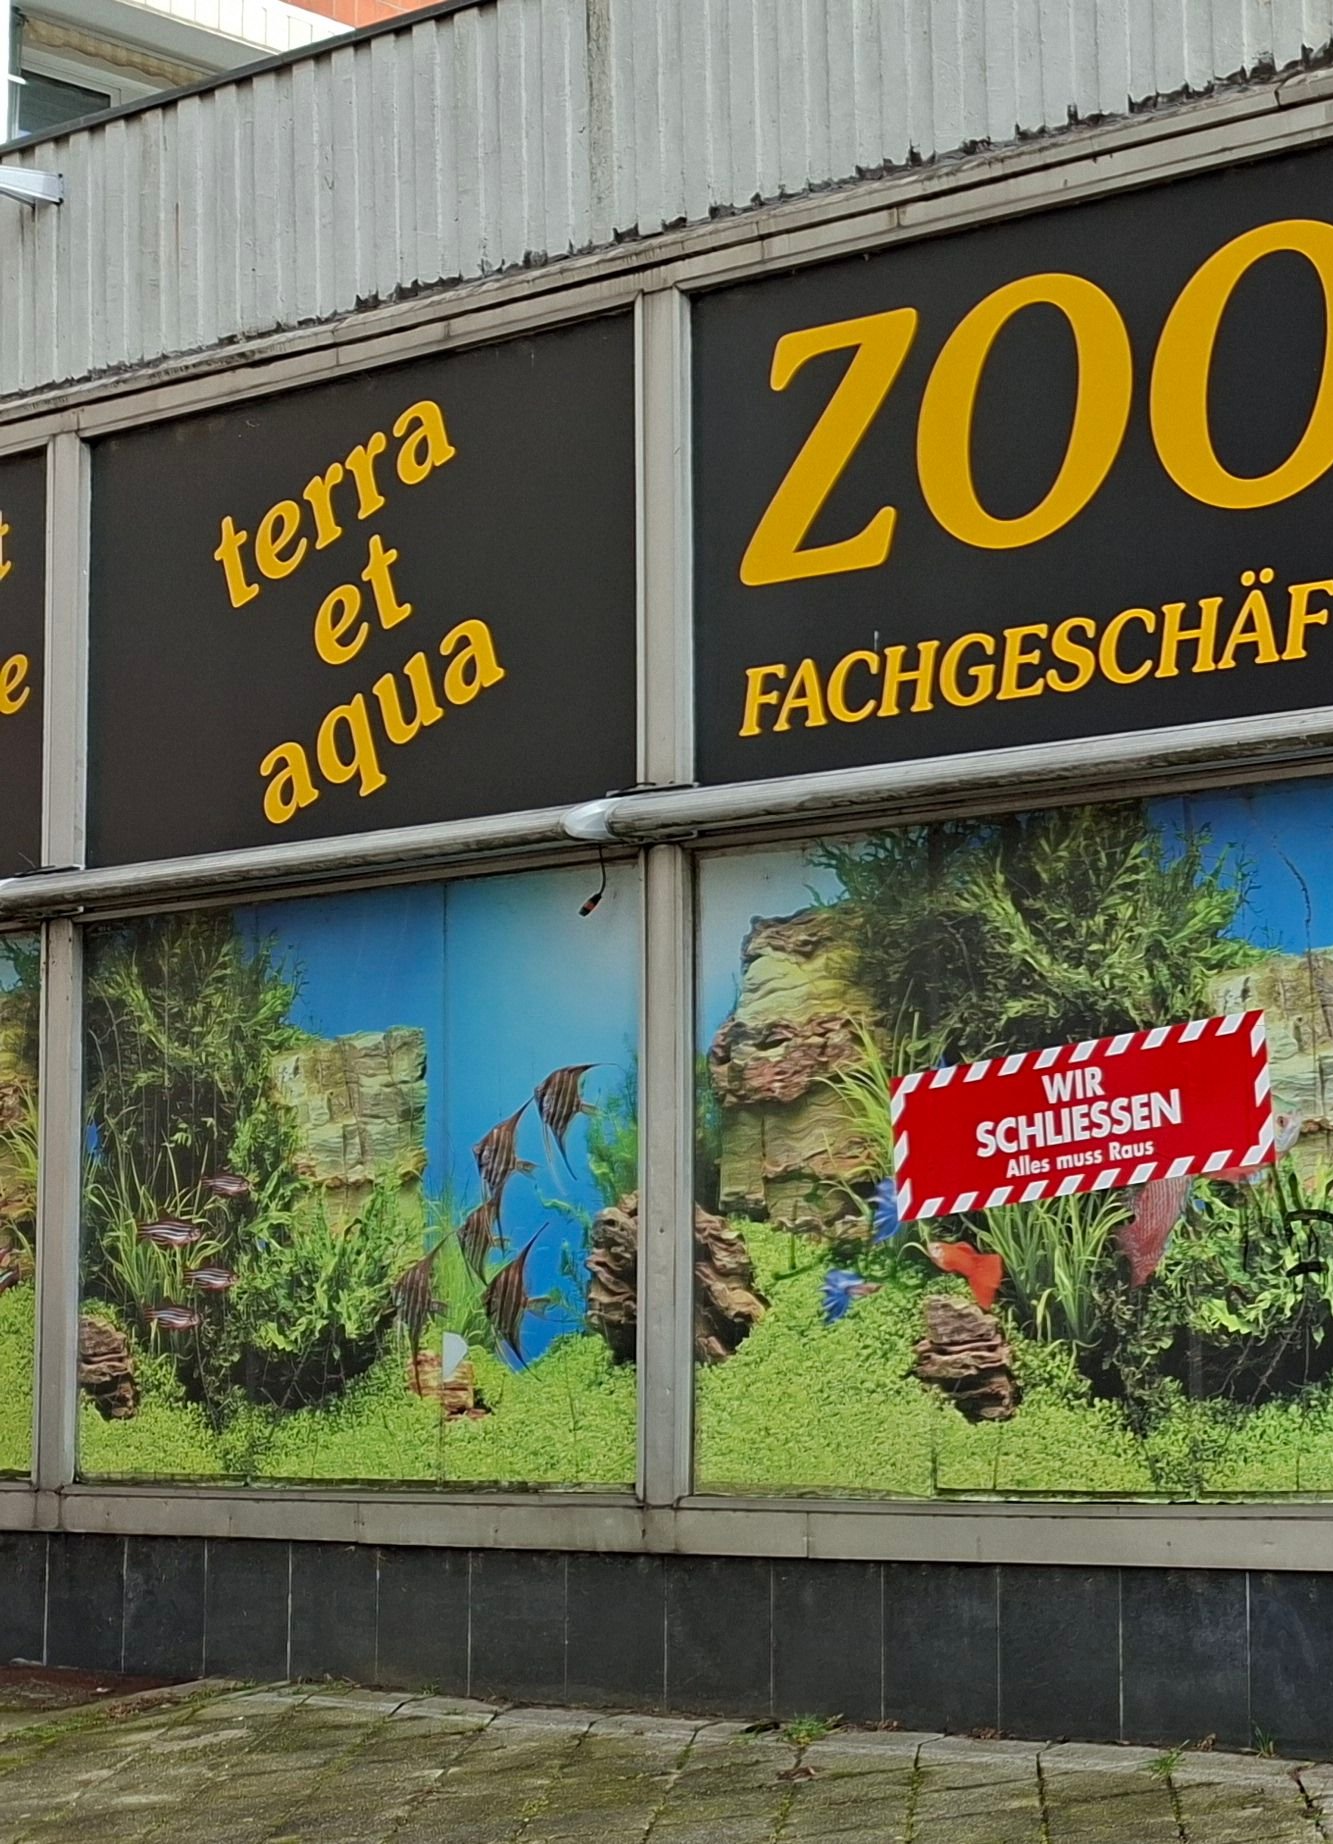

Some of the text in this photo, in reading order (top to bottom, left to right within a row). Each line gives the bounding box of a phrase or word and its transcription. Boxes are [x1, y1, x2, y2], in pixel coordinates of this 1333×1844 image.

[214, 400, 456, 608] terra
[314, 535, 412, 665] et
[260, 619, 505, 824] aqua
[976, 1089, 1183, 1159] SCHLIESSEN
[1041, 1066, 1105, 1105] WIR
[1005, 1140, 1155, 1179] Alles muss Raus
